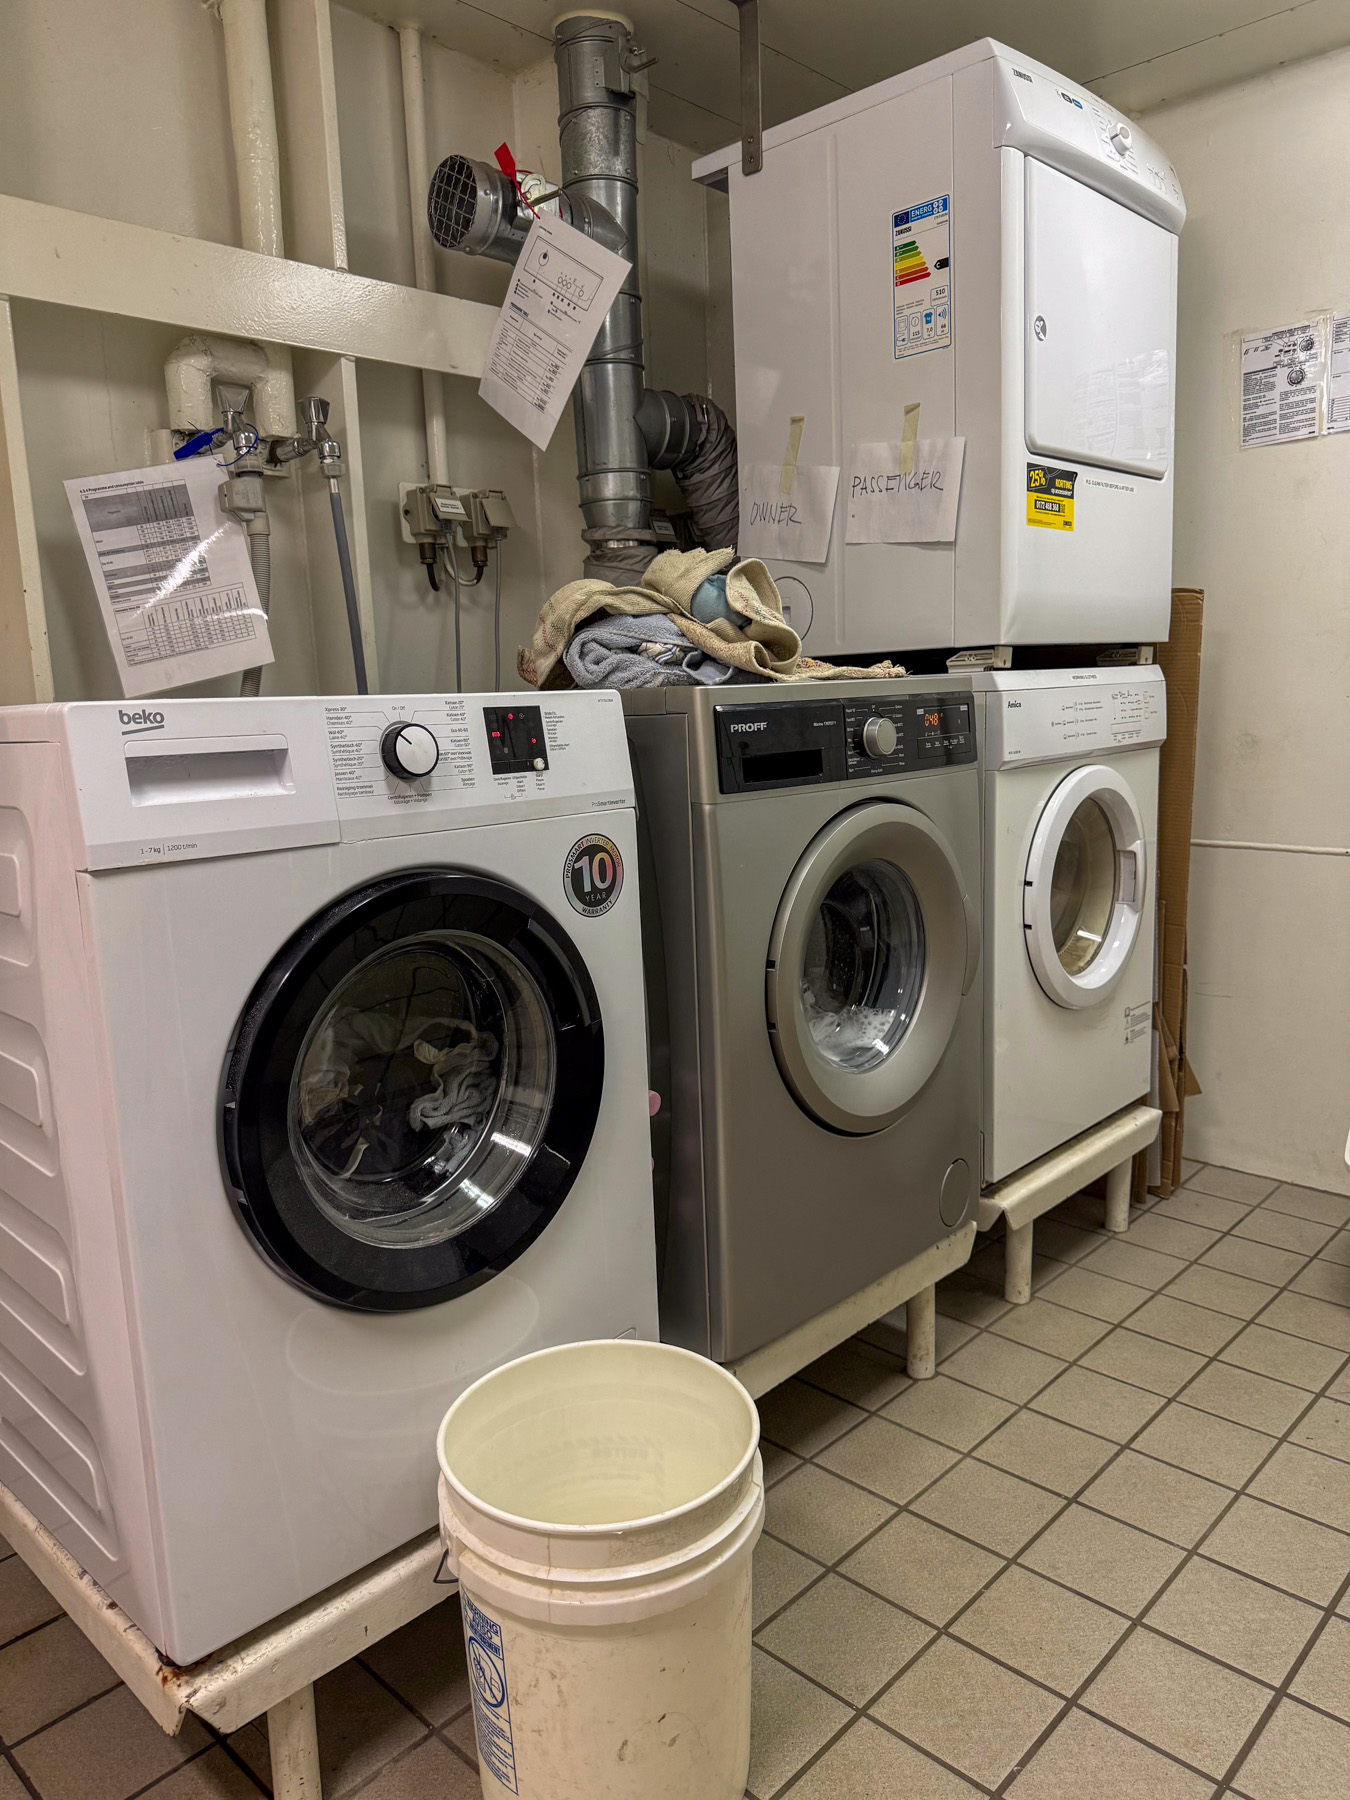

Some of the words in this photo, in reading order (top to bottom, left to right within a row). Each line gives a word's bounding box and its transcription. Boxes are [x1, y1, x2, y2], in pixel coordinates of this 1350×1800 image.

[912, 204, 932, 217] ENERG
[852, 470, 944, 498] PASSENGER
[1030, 470, 1046, 487] 25%
[1055, 478, 1072, 490] KORTING
[1036, 501, 1045, 509] 0172
[750, 502, 802, 526] OWNER
[1008, 700, 1022, 709] Amica
[118, 709, 165, 726] beko
[730, 722, 768, 733] PROFF
[565, 842, 585, 879] PROSMART
[585, 836, 609, 846] INVERTER
[609, 845, 621, 868] MOTOR
[574, 852, 613, 892] 10
[585, 892, 606, 902] YEAR
[582, 899, 613, 914] WARRANTY
[467, 1598, 498, 1634] WARNING
